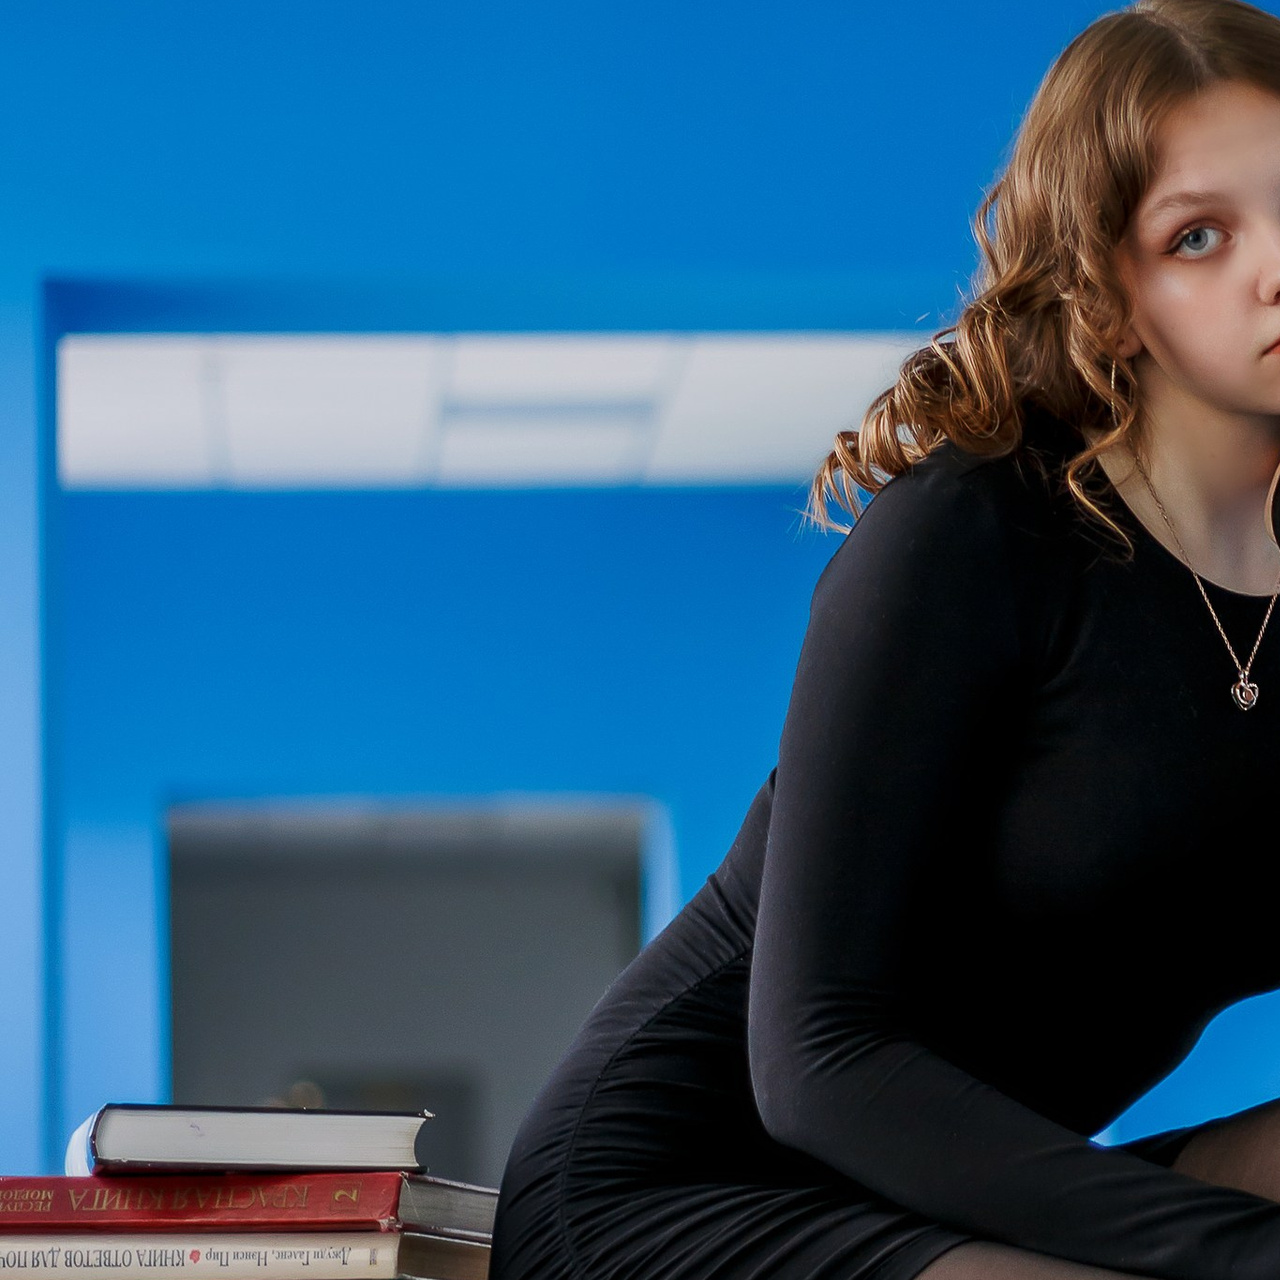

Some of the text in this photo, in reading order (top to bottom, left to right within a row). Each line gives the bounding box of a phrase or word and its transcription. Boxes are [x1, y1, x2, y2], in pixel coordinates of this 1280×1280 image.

[68, 1185, 311, 1212] КРАСНАЯ КНИГА
[333, 1189, 358, 1203] 2
[31, 1246, 61, 1268] ДЛЯ
[64, 1249, 133, 1268] ОТВЕТОВ
[136, 1249, 186, 1267] КНИГА
[205, 1248, 229, 1267] Пир
[232, 1250, 268, 1267] Нэнси
[313, 1246, 352, 1266] Джуди
